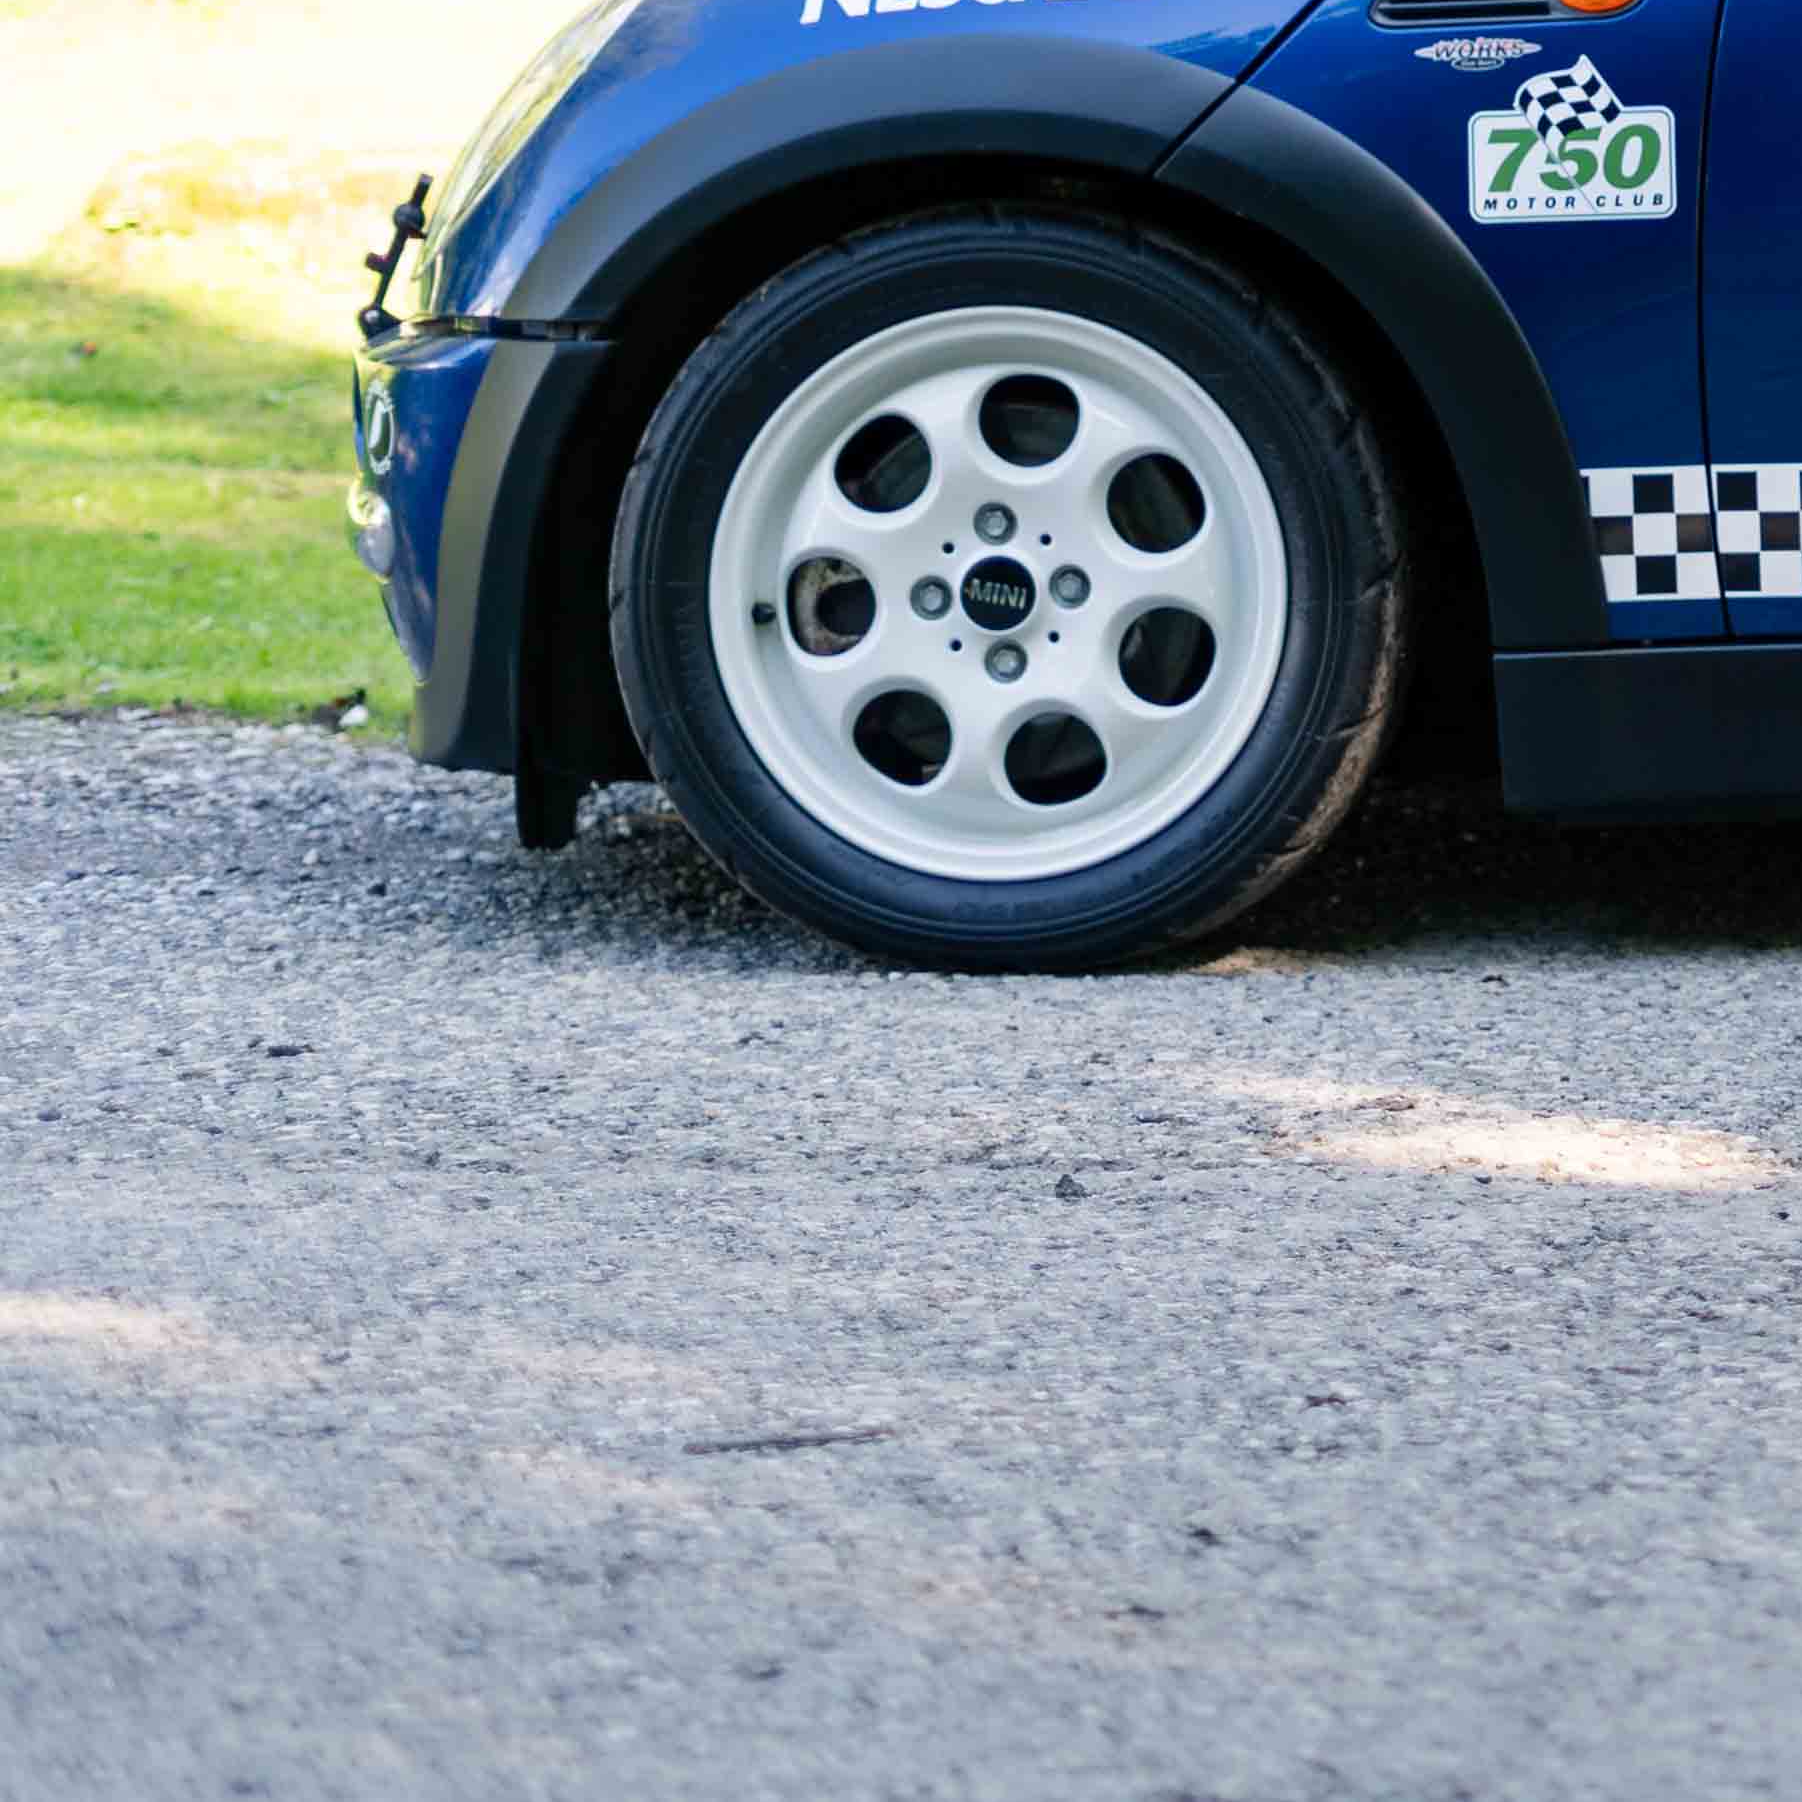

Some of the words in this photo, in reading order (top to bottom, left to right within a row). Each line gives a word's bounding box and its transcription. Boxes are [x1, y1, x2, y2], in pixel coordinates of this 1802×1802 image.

[1487, 123, 1662, 193] 750
[1483, 195, 1576, 211] MOTOR
[1595, 194, 1665, 208] CLUB
[969, 578, 1027, 610] MINI
